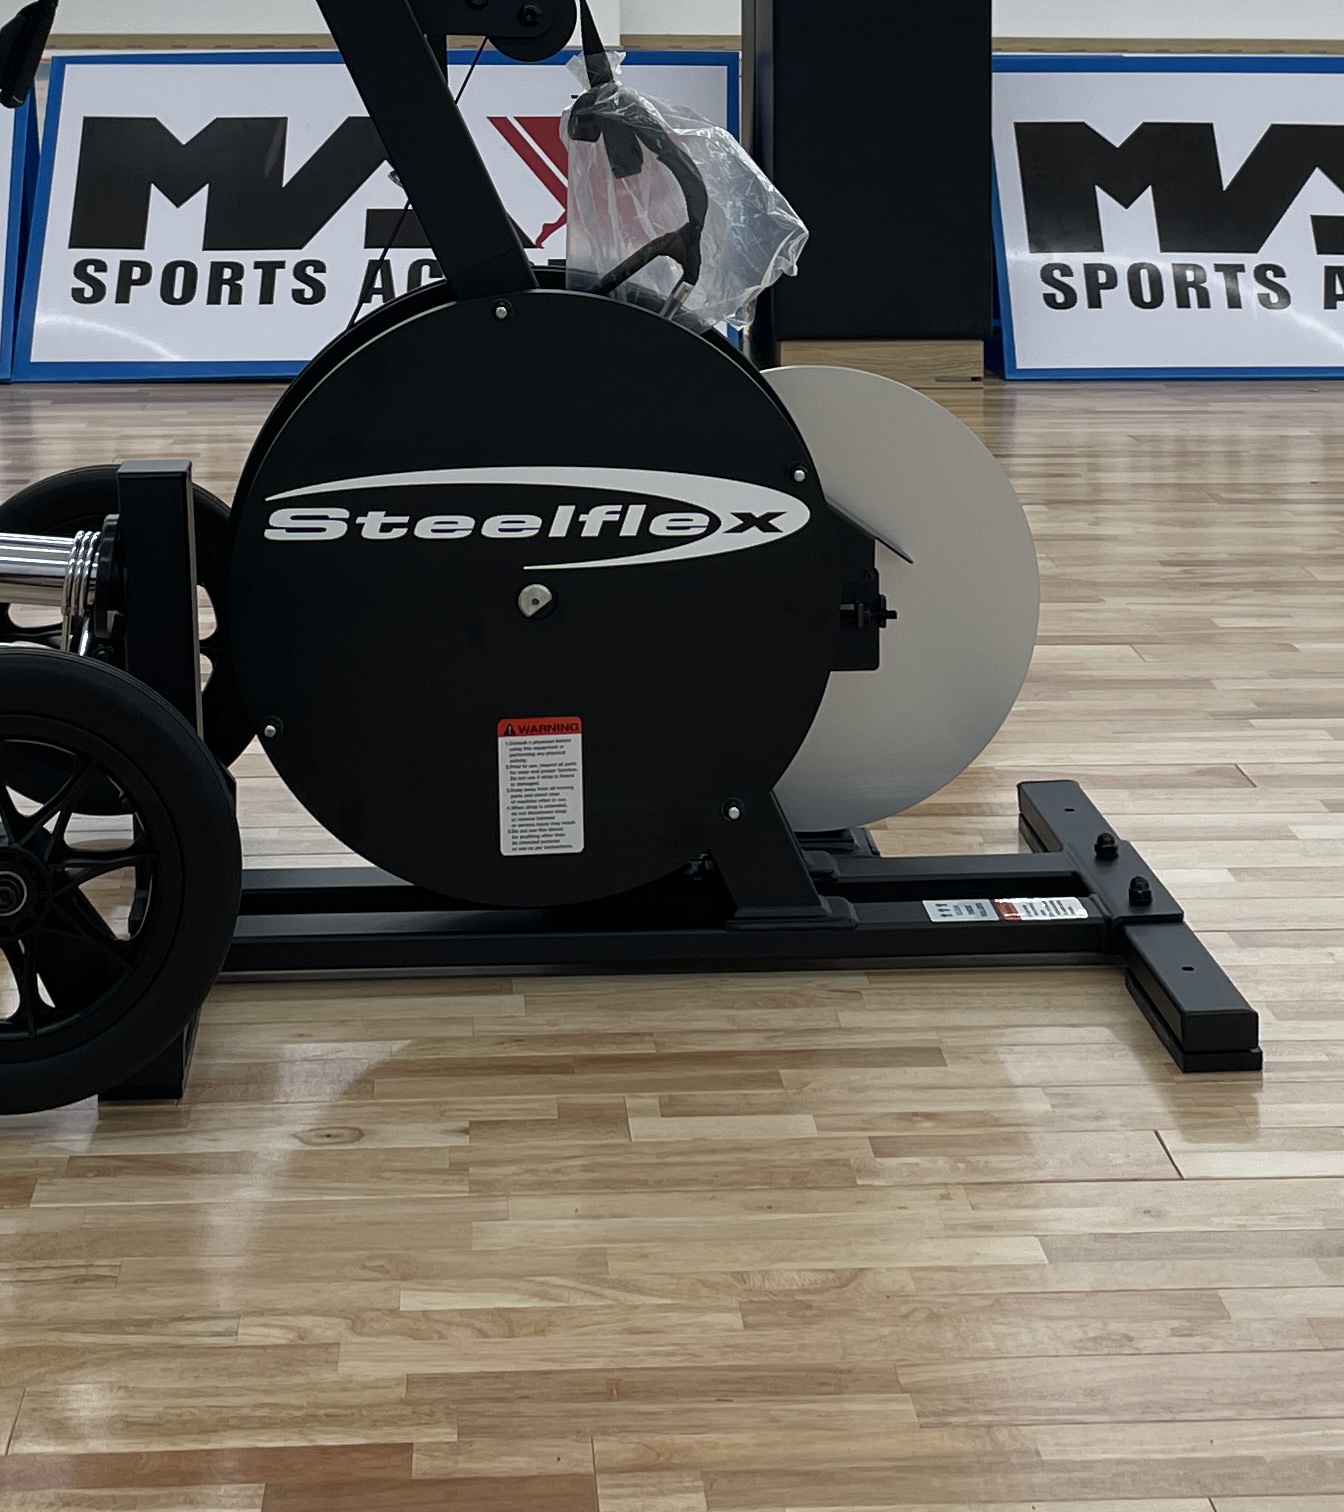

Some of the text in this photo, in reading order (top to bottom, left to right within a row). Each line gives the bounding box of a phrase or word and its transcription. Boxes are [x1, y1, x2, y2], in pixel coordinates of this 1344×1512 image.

[71, 258, 327, 306] SPORTS
[1039, 262, 1292, 310] SPORTS
[264, 504, 788, 541] Steelflex
[518, 723, 579, 734] WARNING
